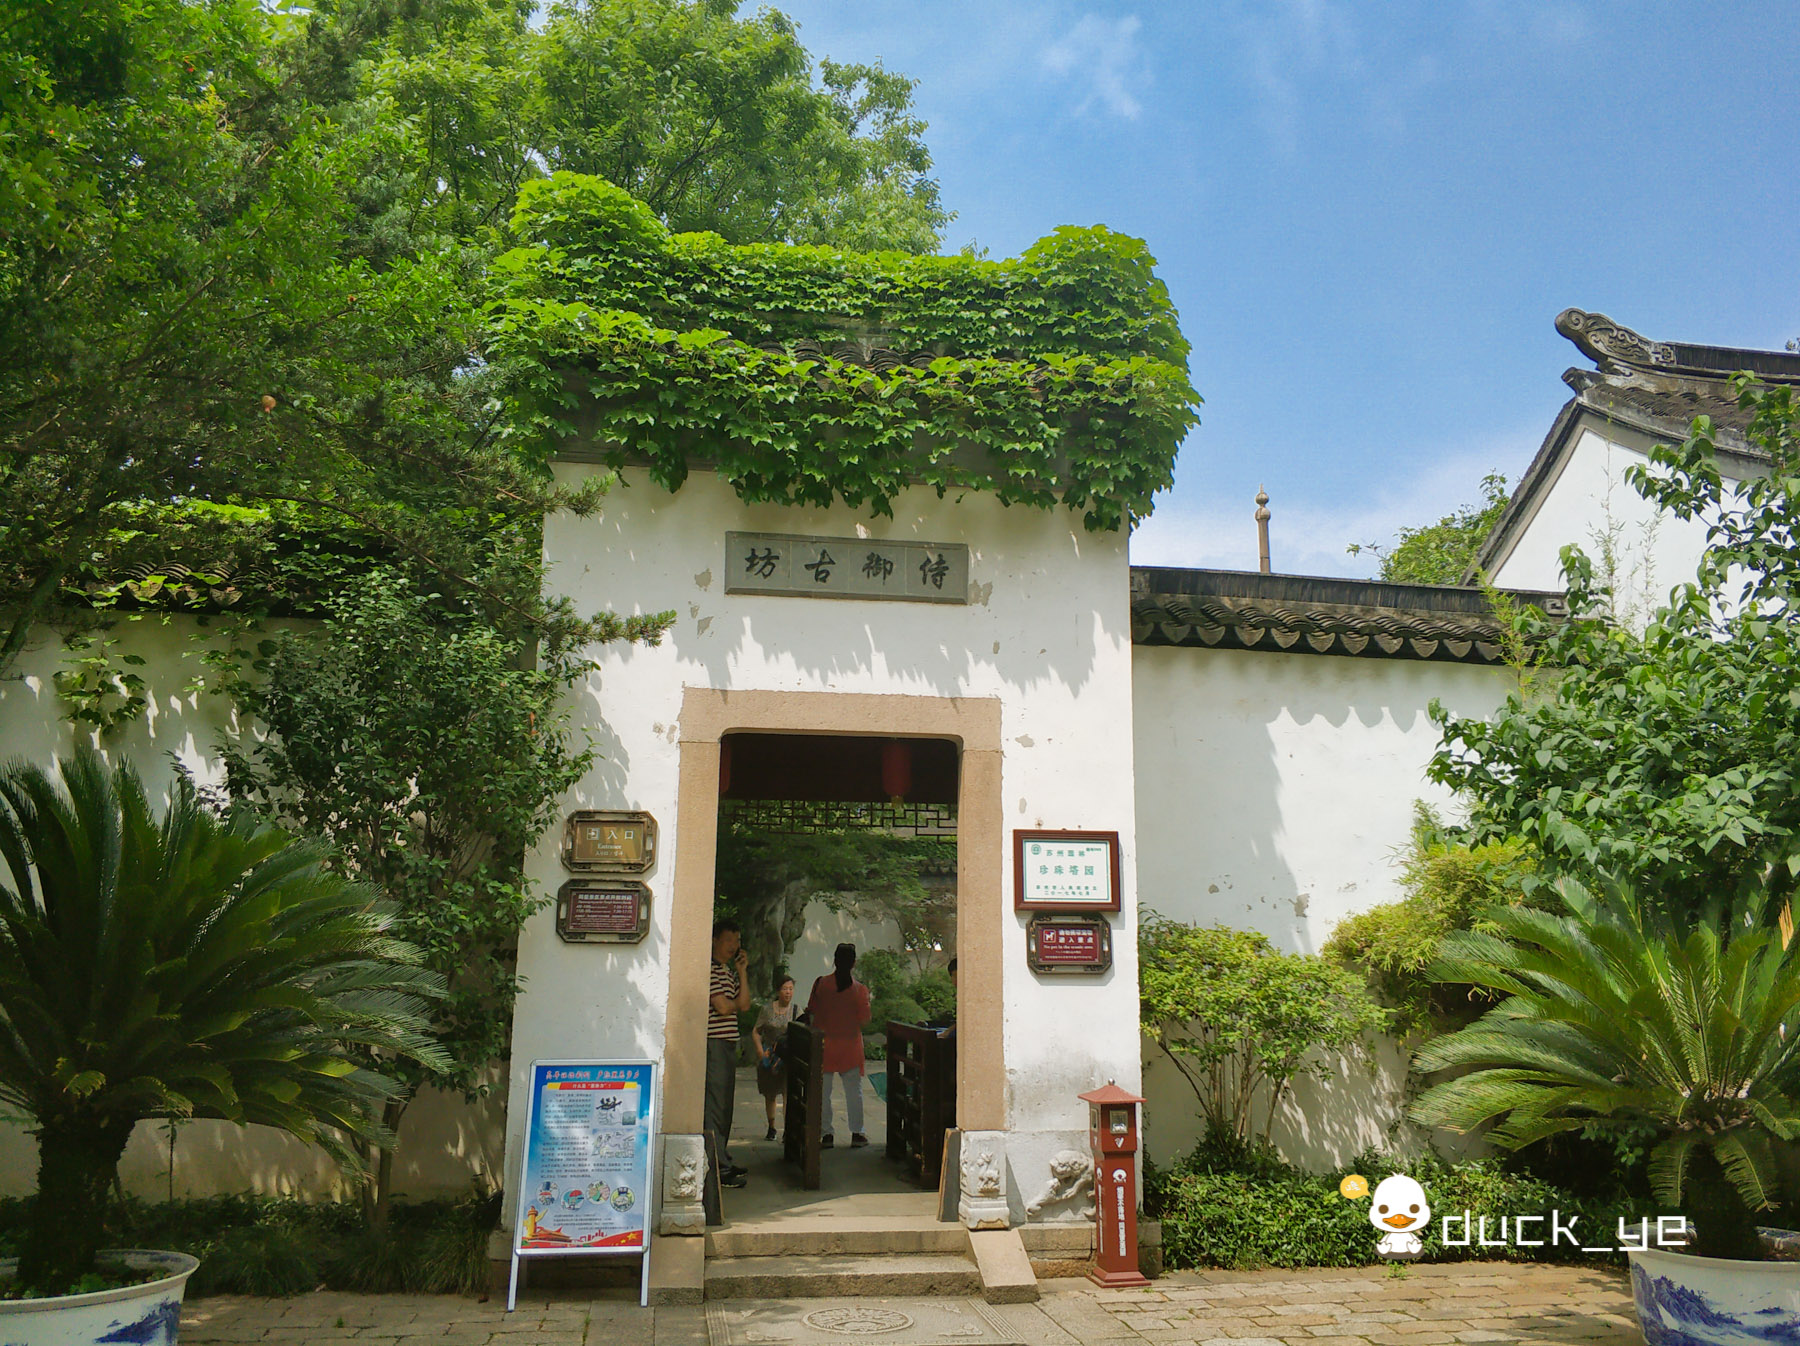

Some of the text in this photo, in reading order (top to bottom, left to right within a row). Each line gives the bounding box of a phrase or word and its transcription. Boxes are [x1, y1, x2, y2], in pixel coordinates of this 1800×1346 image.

[607, 830, 634, 840] 入口
[1039, 865, 1094, 875] 珍珠塔园
